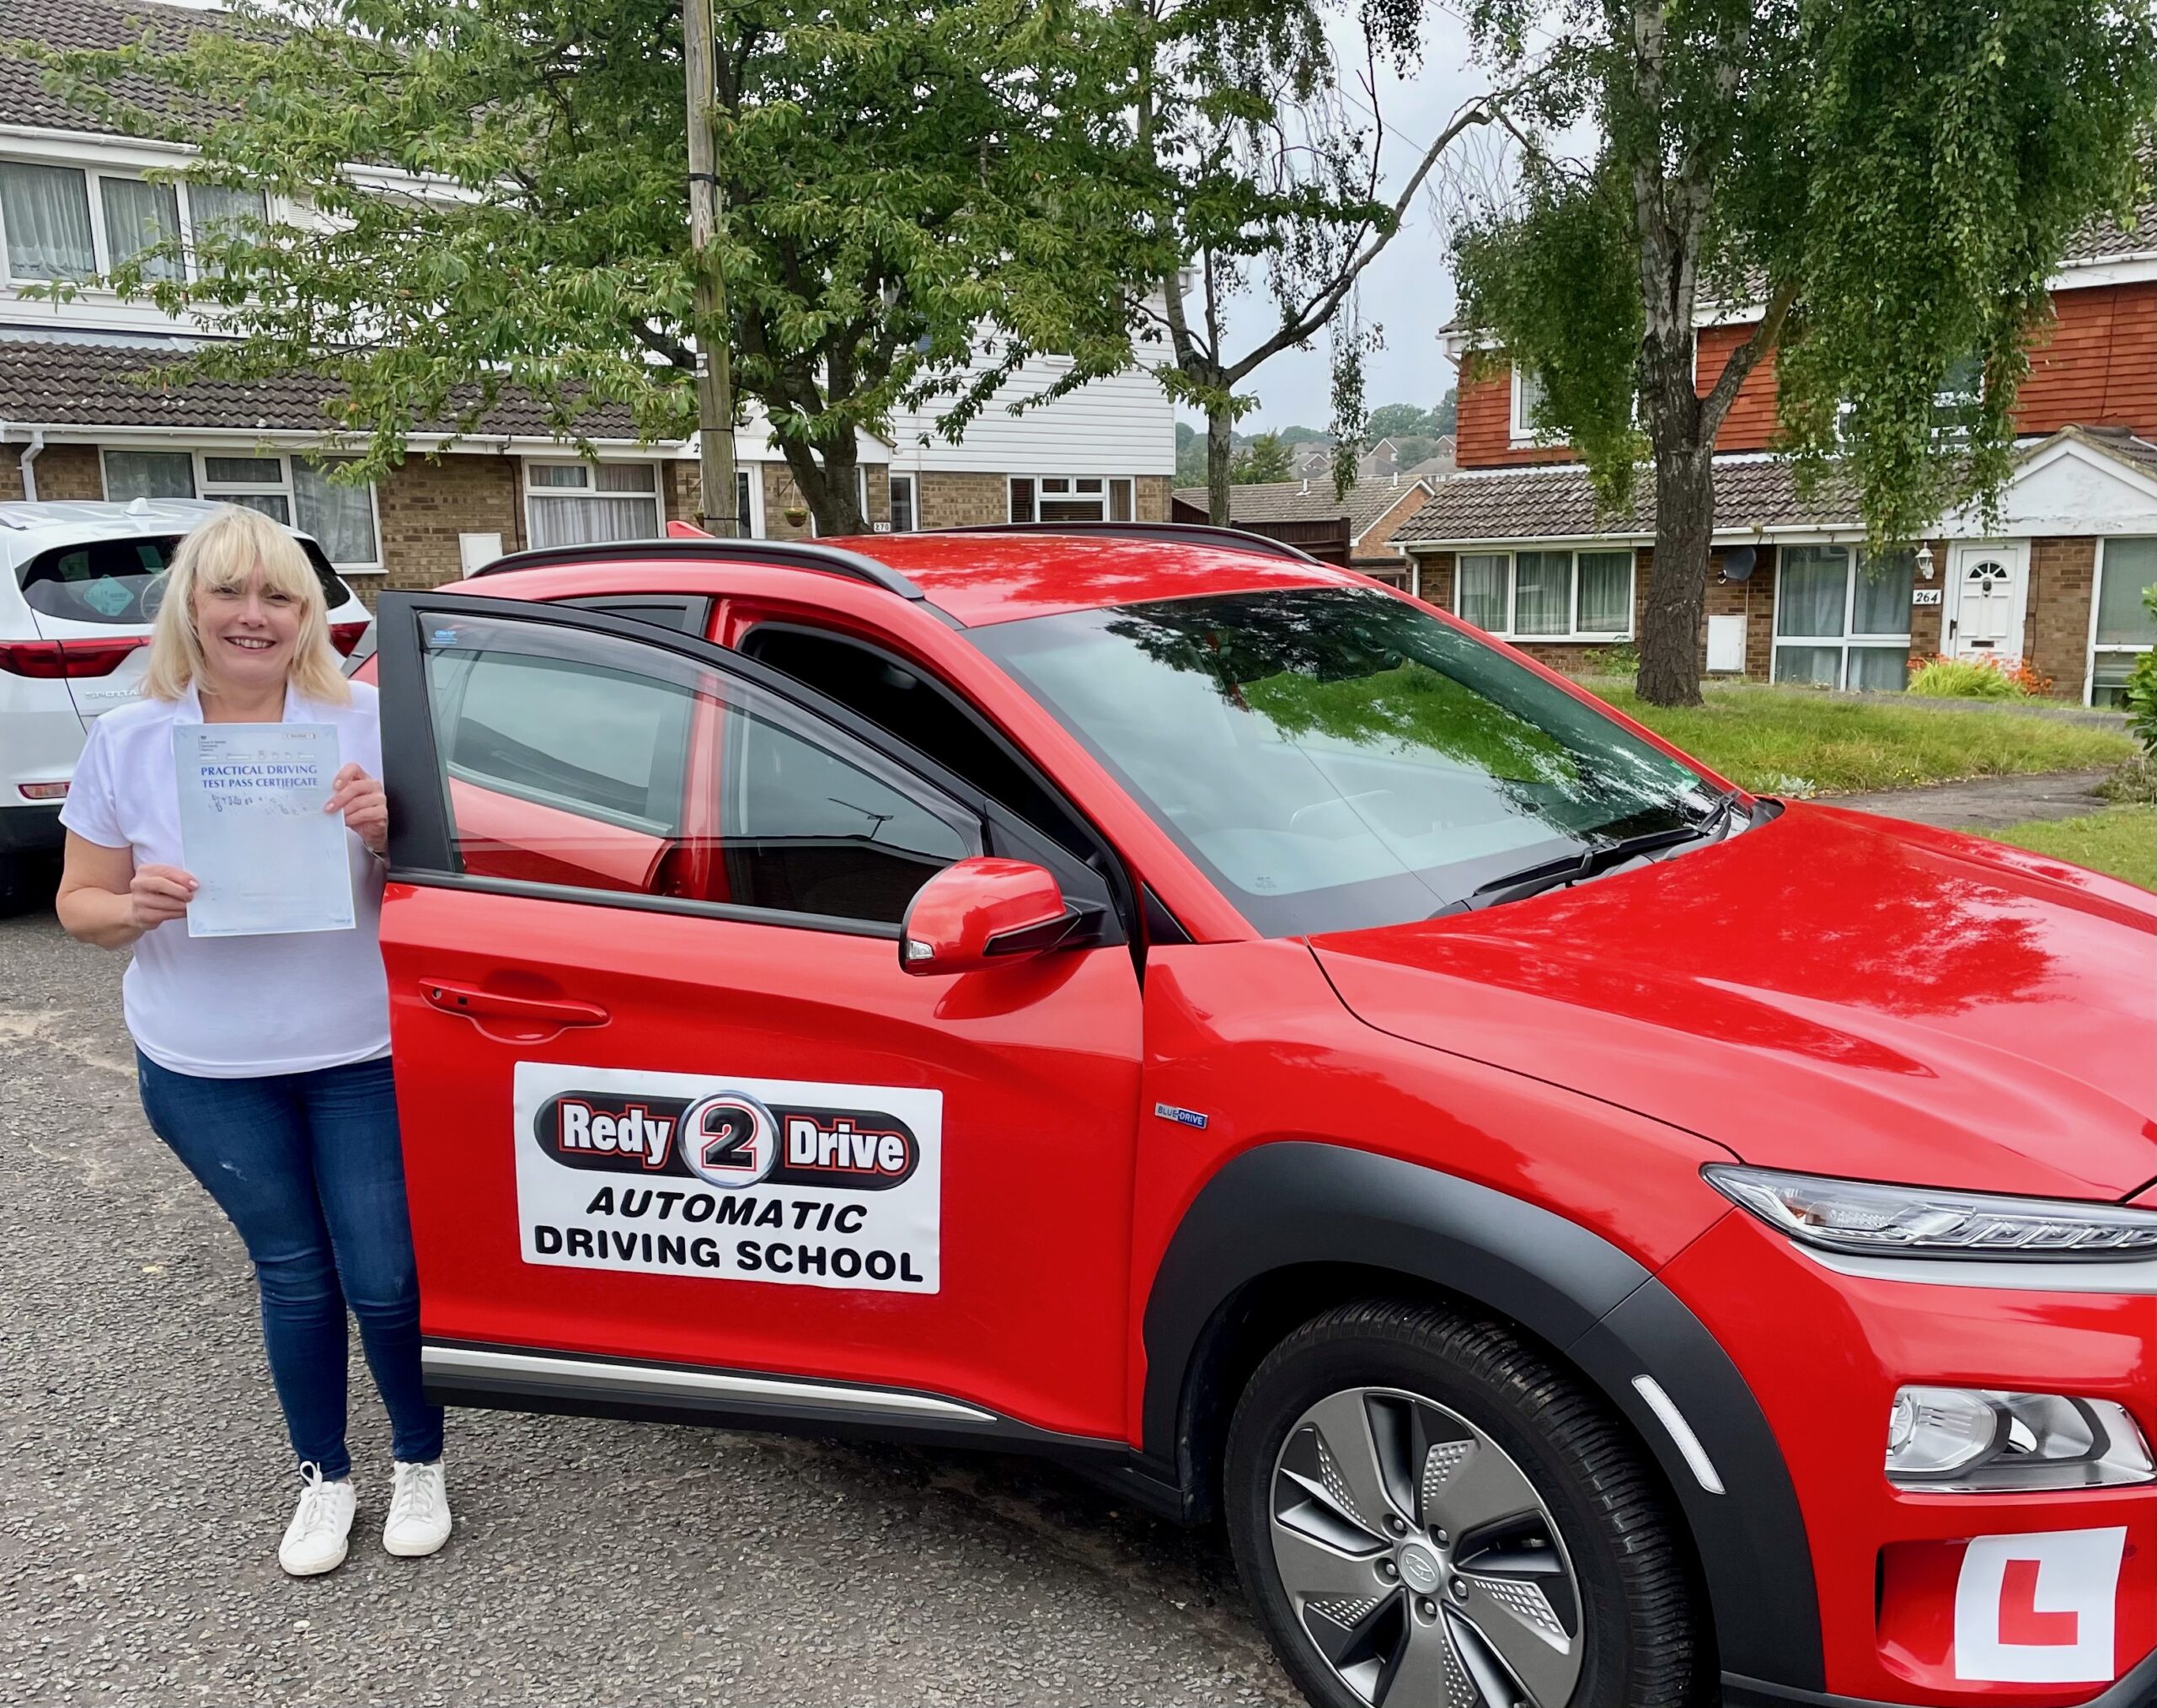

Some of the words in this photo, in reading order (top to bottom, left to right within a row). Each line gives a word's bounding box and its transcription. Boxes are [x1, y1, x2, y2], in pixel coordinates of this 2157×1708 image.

[1915, 592, 1939, 604] 264
[85, 689, 140, 699] SPORTA
[201, 765, 264, 776] PRACTICAL
[267, 764, 318, 774] DRIVING
[202, 779, 226, 789] TEST
[228, 779, 253, 788] PASS
[255, 777, 318, 789] CERTIFICATE
[561, 1102, 674, 1167] Redy
[703, 1105, 757, 1170] 2
[788, 1118, 907, 1172] Drive
[586, 1186, 868, 1234] AUTOMATIC
[534, 1224, 720, 1268] DRIVING
[737, 1240, 923, 1282] SCHOOL
[1998, 1559, 2079, 1646] L
